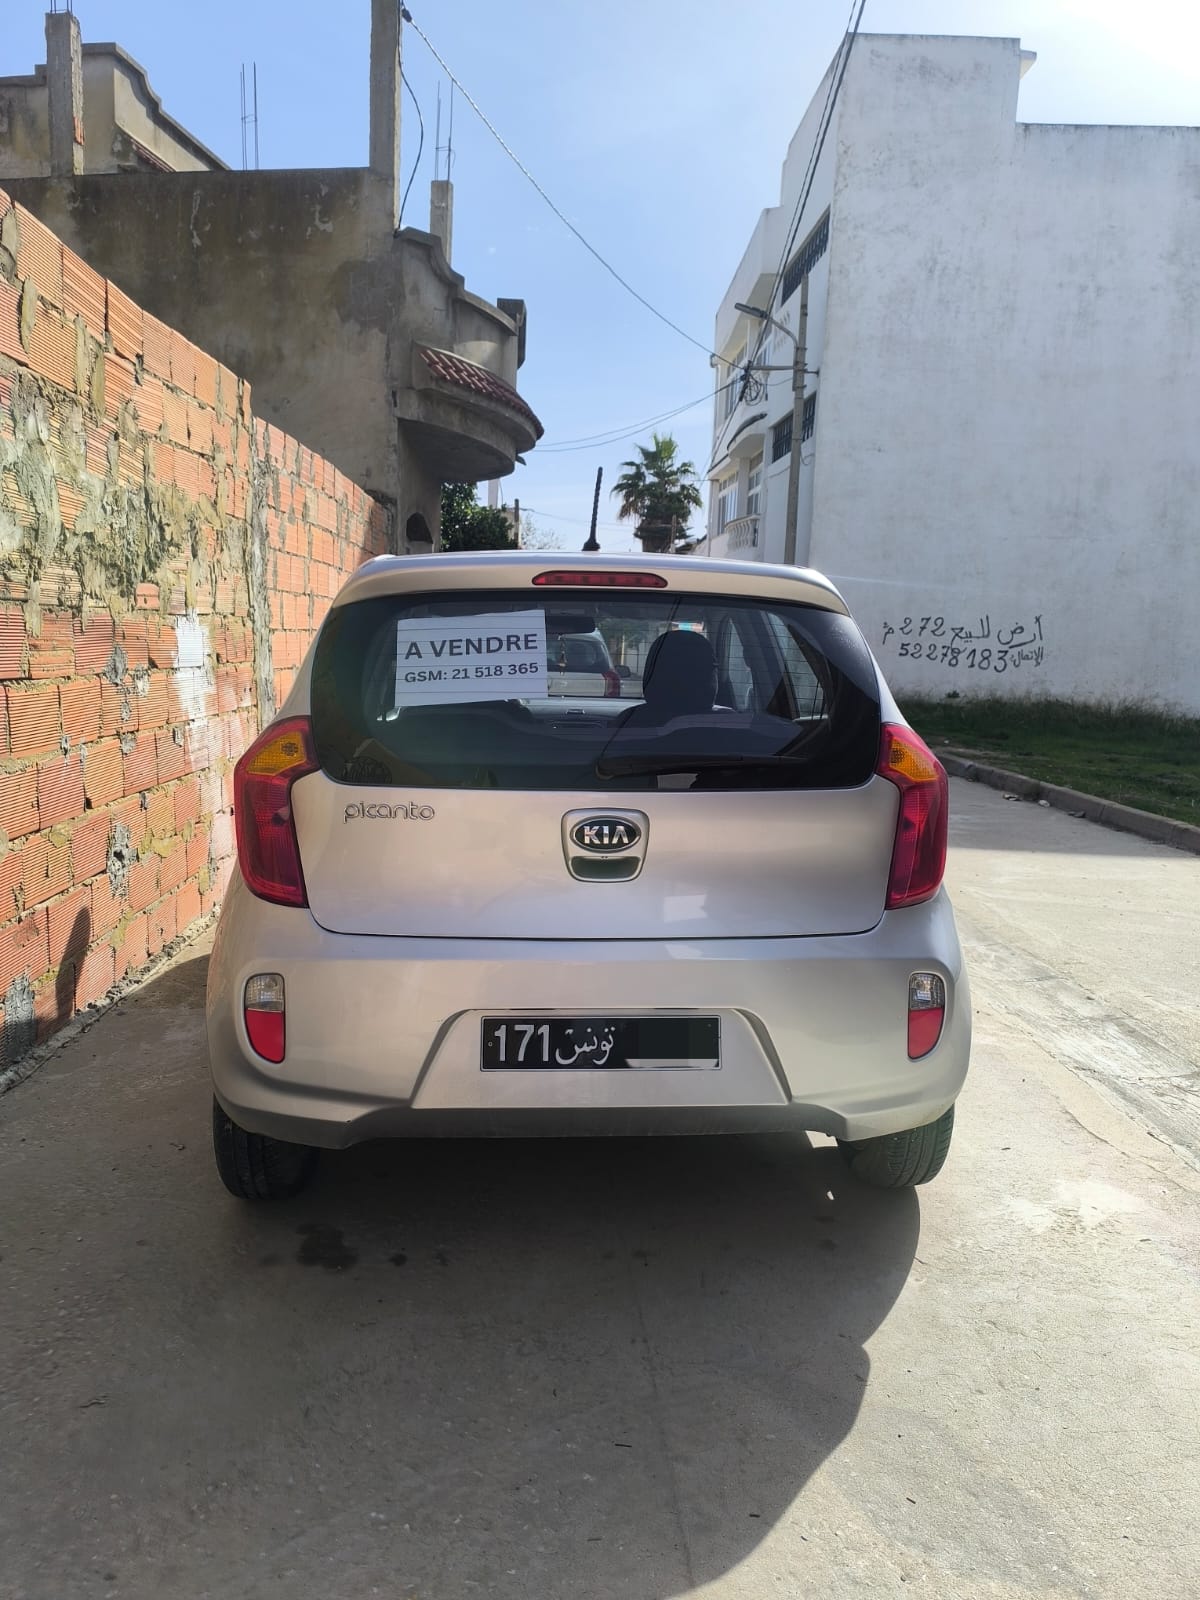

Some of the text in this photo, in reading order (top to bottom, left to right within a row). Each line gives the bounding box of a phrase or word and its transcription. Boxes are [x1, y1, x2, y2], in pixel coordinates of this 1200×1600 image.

[899, 617, 946, 637] 272
[404, 633, 538, 660] A VENDRE
[899, 643, 1009, 673] 52278183
[404, 662, 538, 683] GSM: 21 518 365
[343, 802, 435, 823] picanto
[584, 825, 629, 845] KIA
[494, 1024, 616, 1065] 171 تونس
